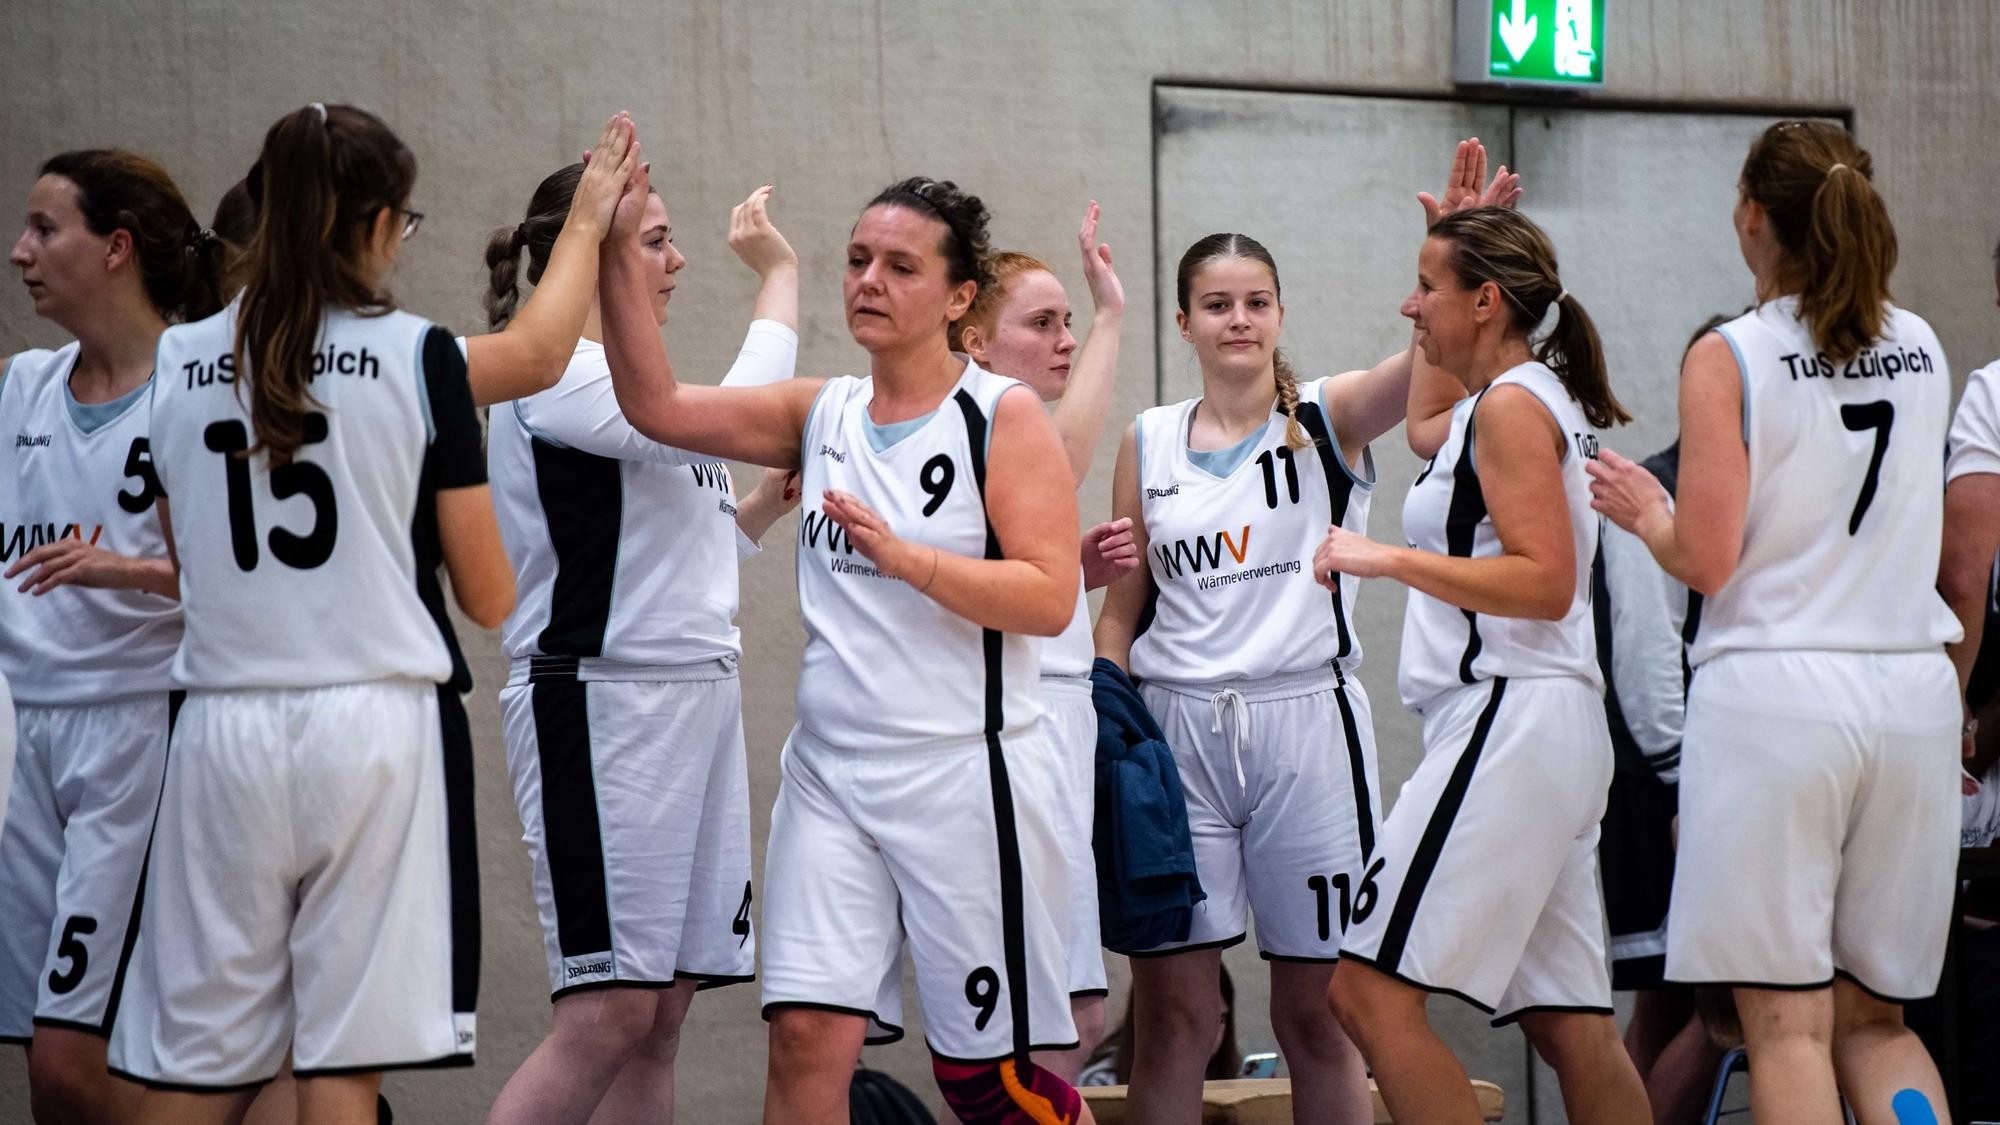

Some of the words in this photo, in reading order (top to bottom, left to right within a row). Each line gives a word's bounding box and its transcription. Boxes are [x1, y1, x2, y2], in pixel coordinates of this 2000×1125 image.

[183, 354, 235, 390] TuS
[309, 344, 379, 384] pich
[1780, 352, 1835, 380] TuS
[1843, 346, 1933, 380] Zülpich
[117, 436, 155, 514] 5
[204, 411, 338, 572] 15
[920, 453, 955, 517] 9
[1255, 445, 1300, 510] 11
[1841, 400, 1894, 536] 7
[801, 507, 854, 554] WW
[1154, 525, 1250, 579] WWV
[1197, 560, 1301, 591] Wärmeverwertung
[732, 879, 752, 950] 4
[1307, 873, 1351, 941] 11
[1352, 856, 1386, 925] 6
[48, 915, 98, 995] 5
[568, 961, 611, 979] SPALDING
[965, 966, 1000, 1031] 9
